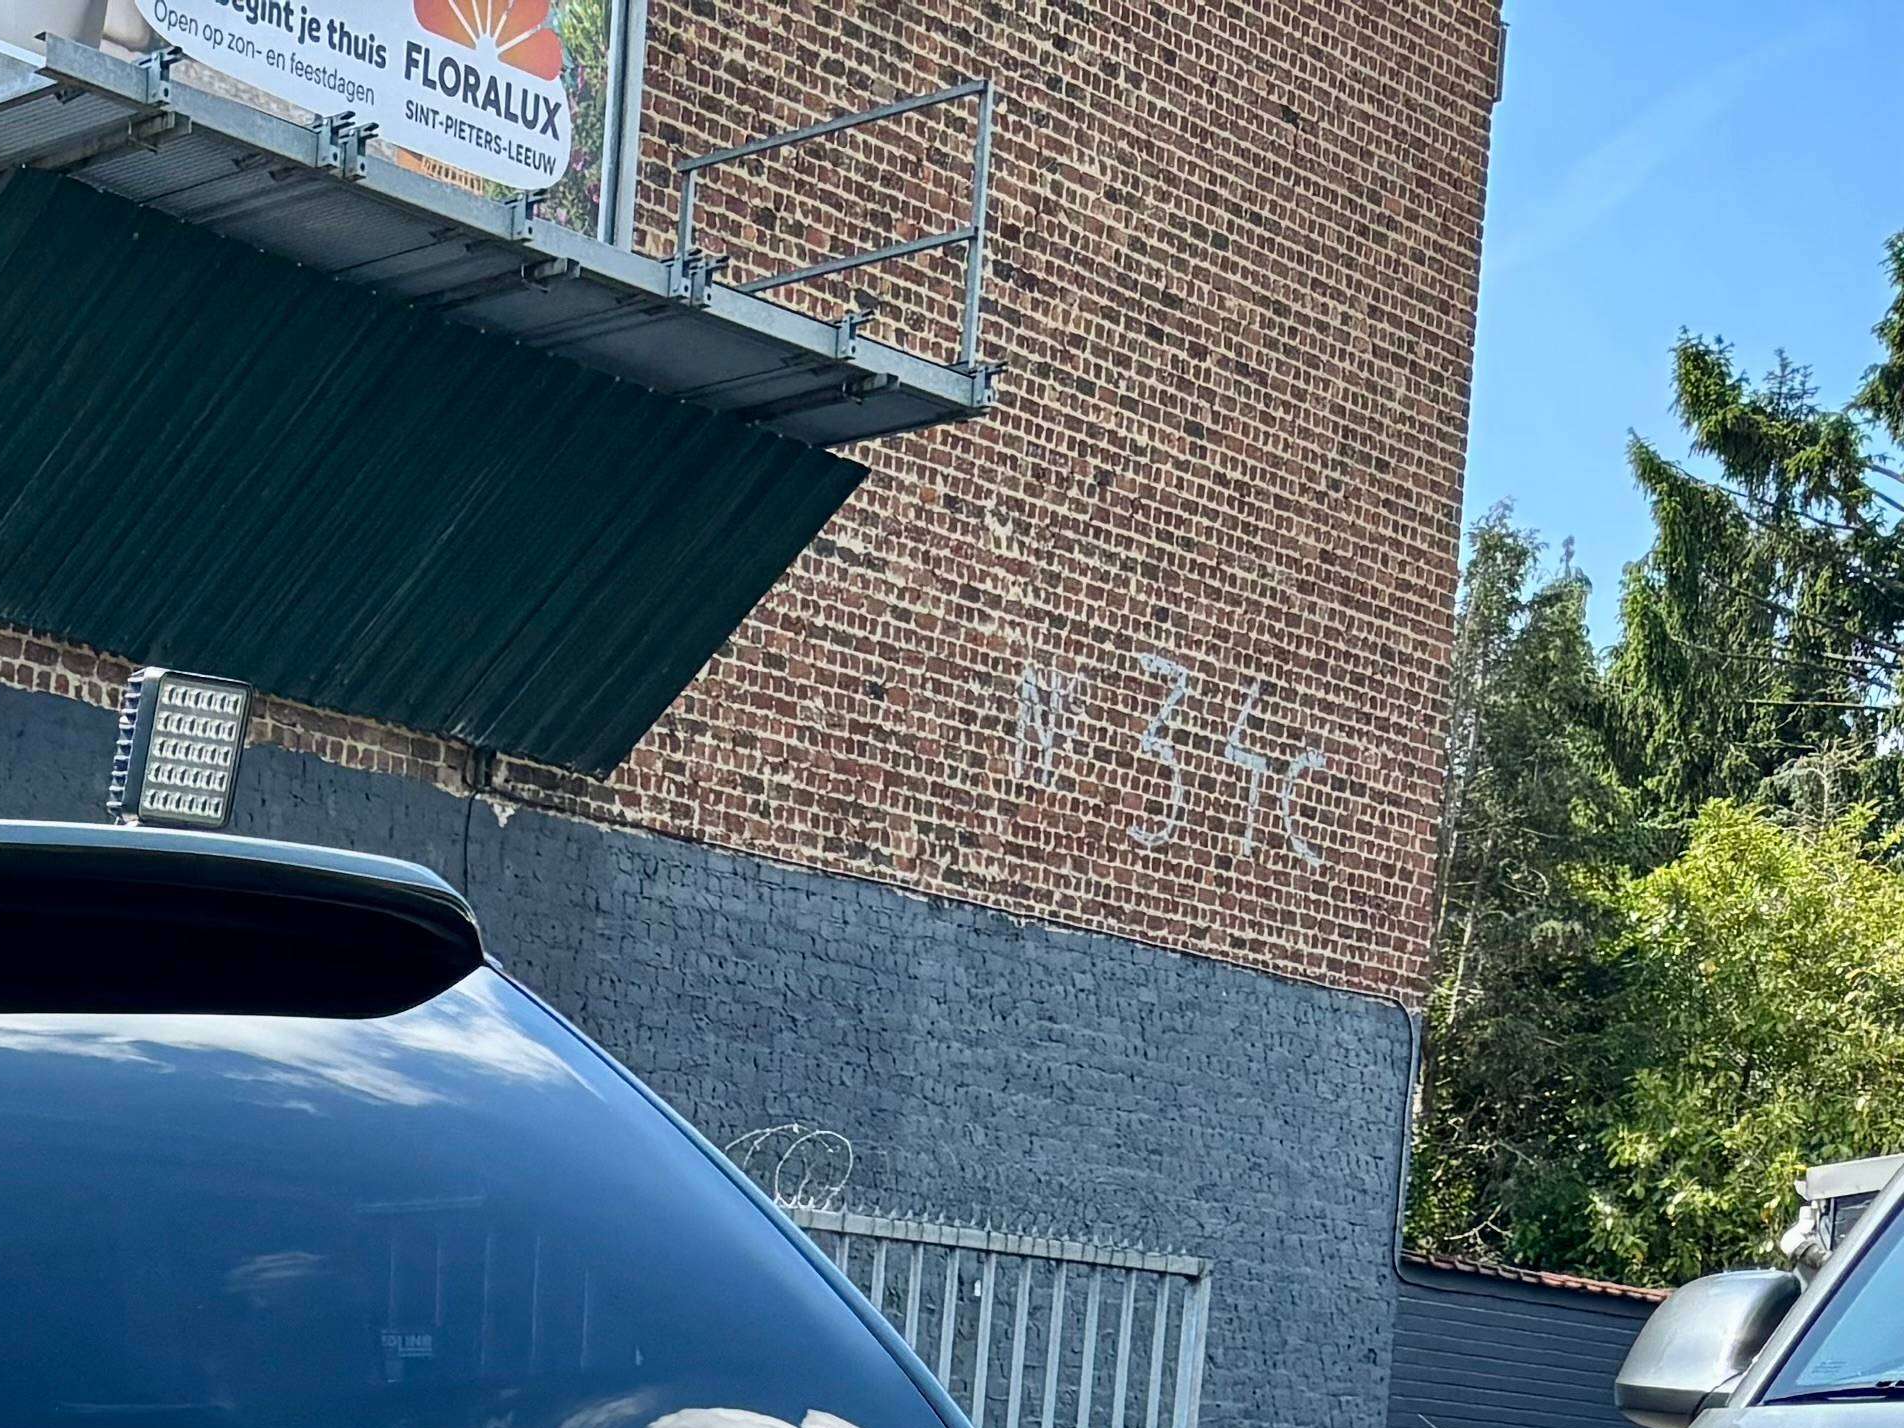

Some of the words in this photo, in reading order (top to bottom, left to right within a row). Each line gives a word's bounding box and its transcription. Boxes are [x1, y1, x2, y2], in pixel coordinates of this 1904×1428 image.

[154, 0, 198, 37] Open
[202, 24, 223, 49] op
[228, 32, 263, 59] zon-
[266, 48, 286, 71] en
[290, 52, 375, 106] feestdagen
[297, 6, 321, 45] je
[327, 18, 387, 69] thuis
[404, 40, 562, 142] FLORALUX
[405, 99, 557, 177] SINT-PIETERS-LEEUW
